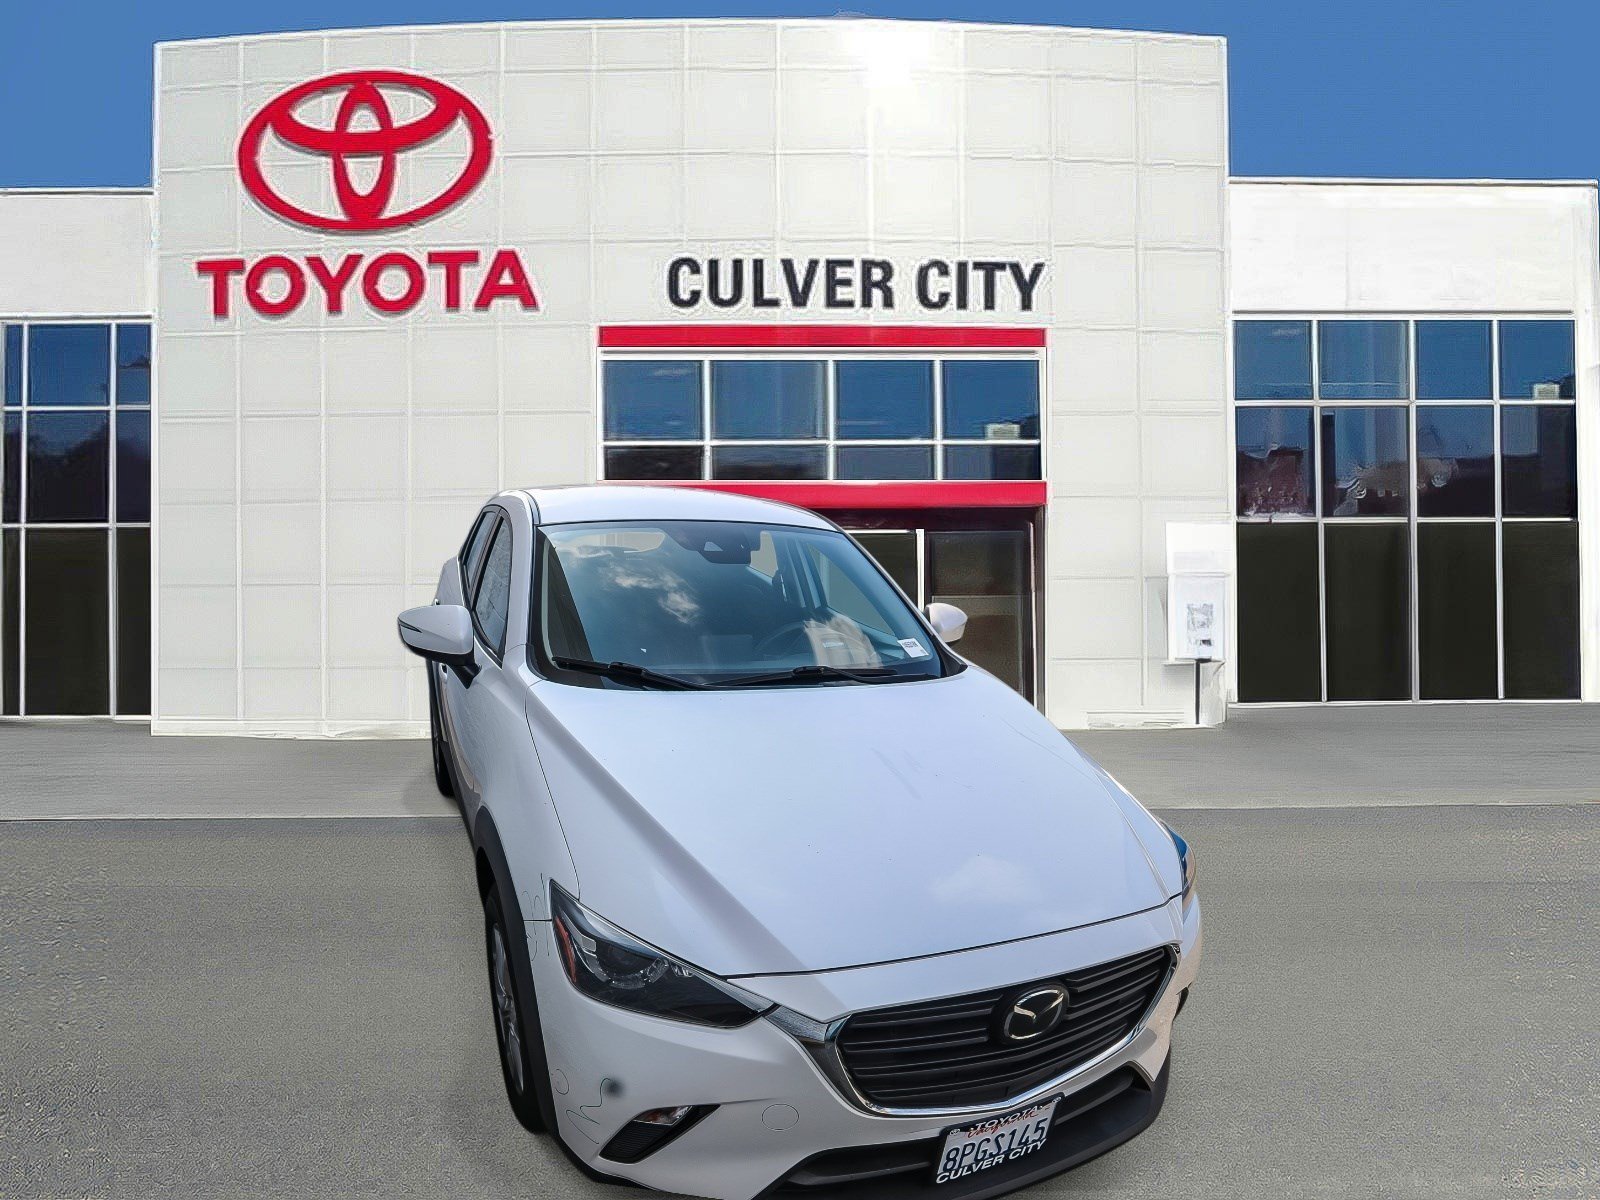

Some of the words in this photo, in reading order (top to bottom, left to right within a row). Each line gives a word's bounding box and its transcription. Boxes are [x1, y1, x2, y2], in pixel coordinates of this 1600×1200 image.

[197, 250, 537, 317] TOYOTA
[669, 257, 895, 309] CULVER
[917, 259, 1046, 312] CITY
[942, 1117, 1048, 1173] 8PGS145
[976, 1105, 1039, 1130] TOYOTA
[936, 1154, 1004, 1184] CULVER
[1008, 1138, 1047, 1160] CITY
